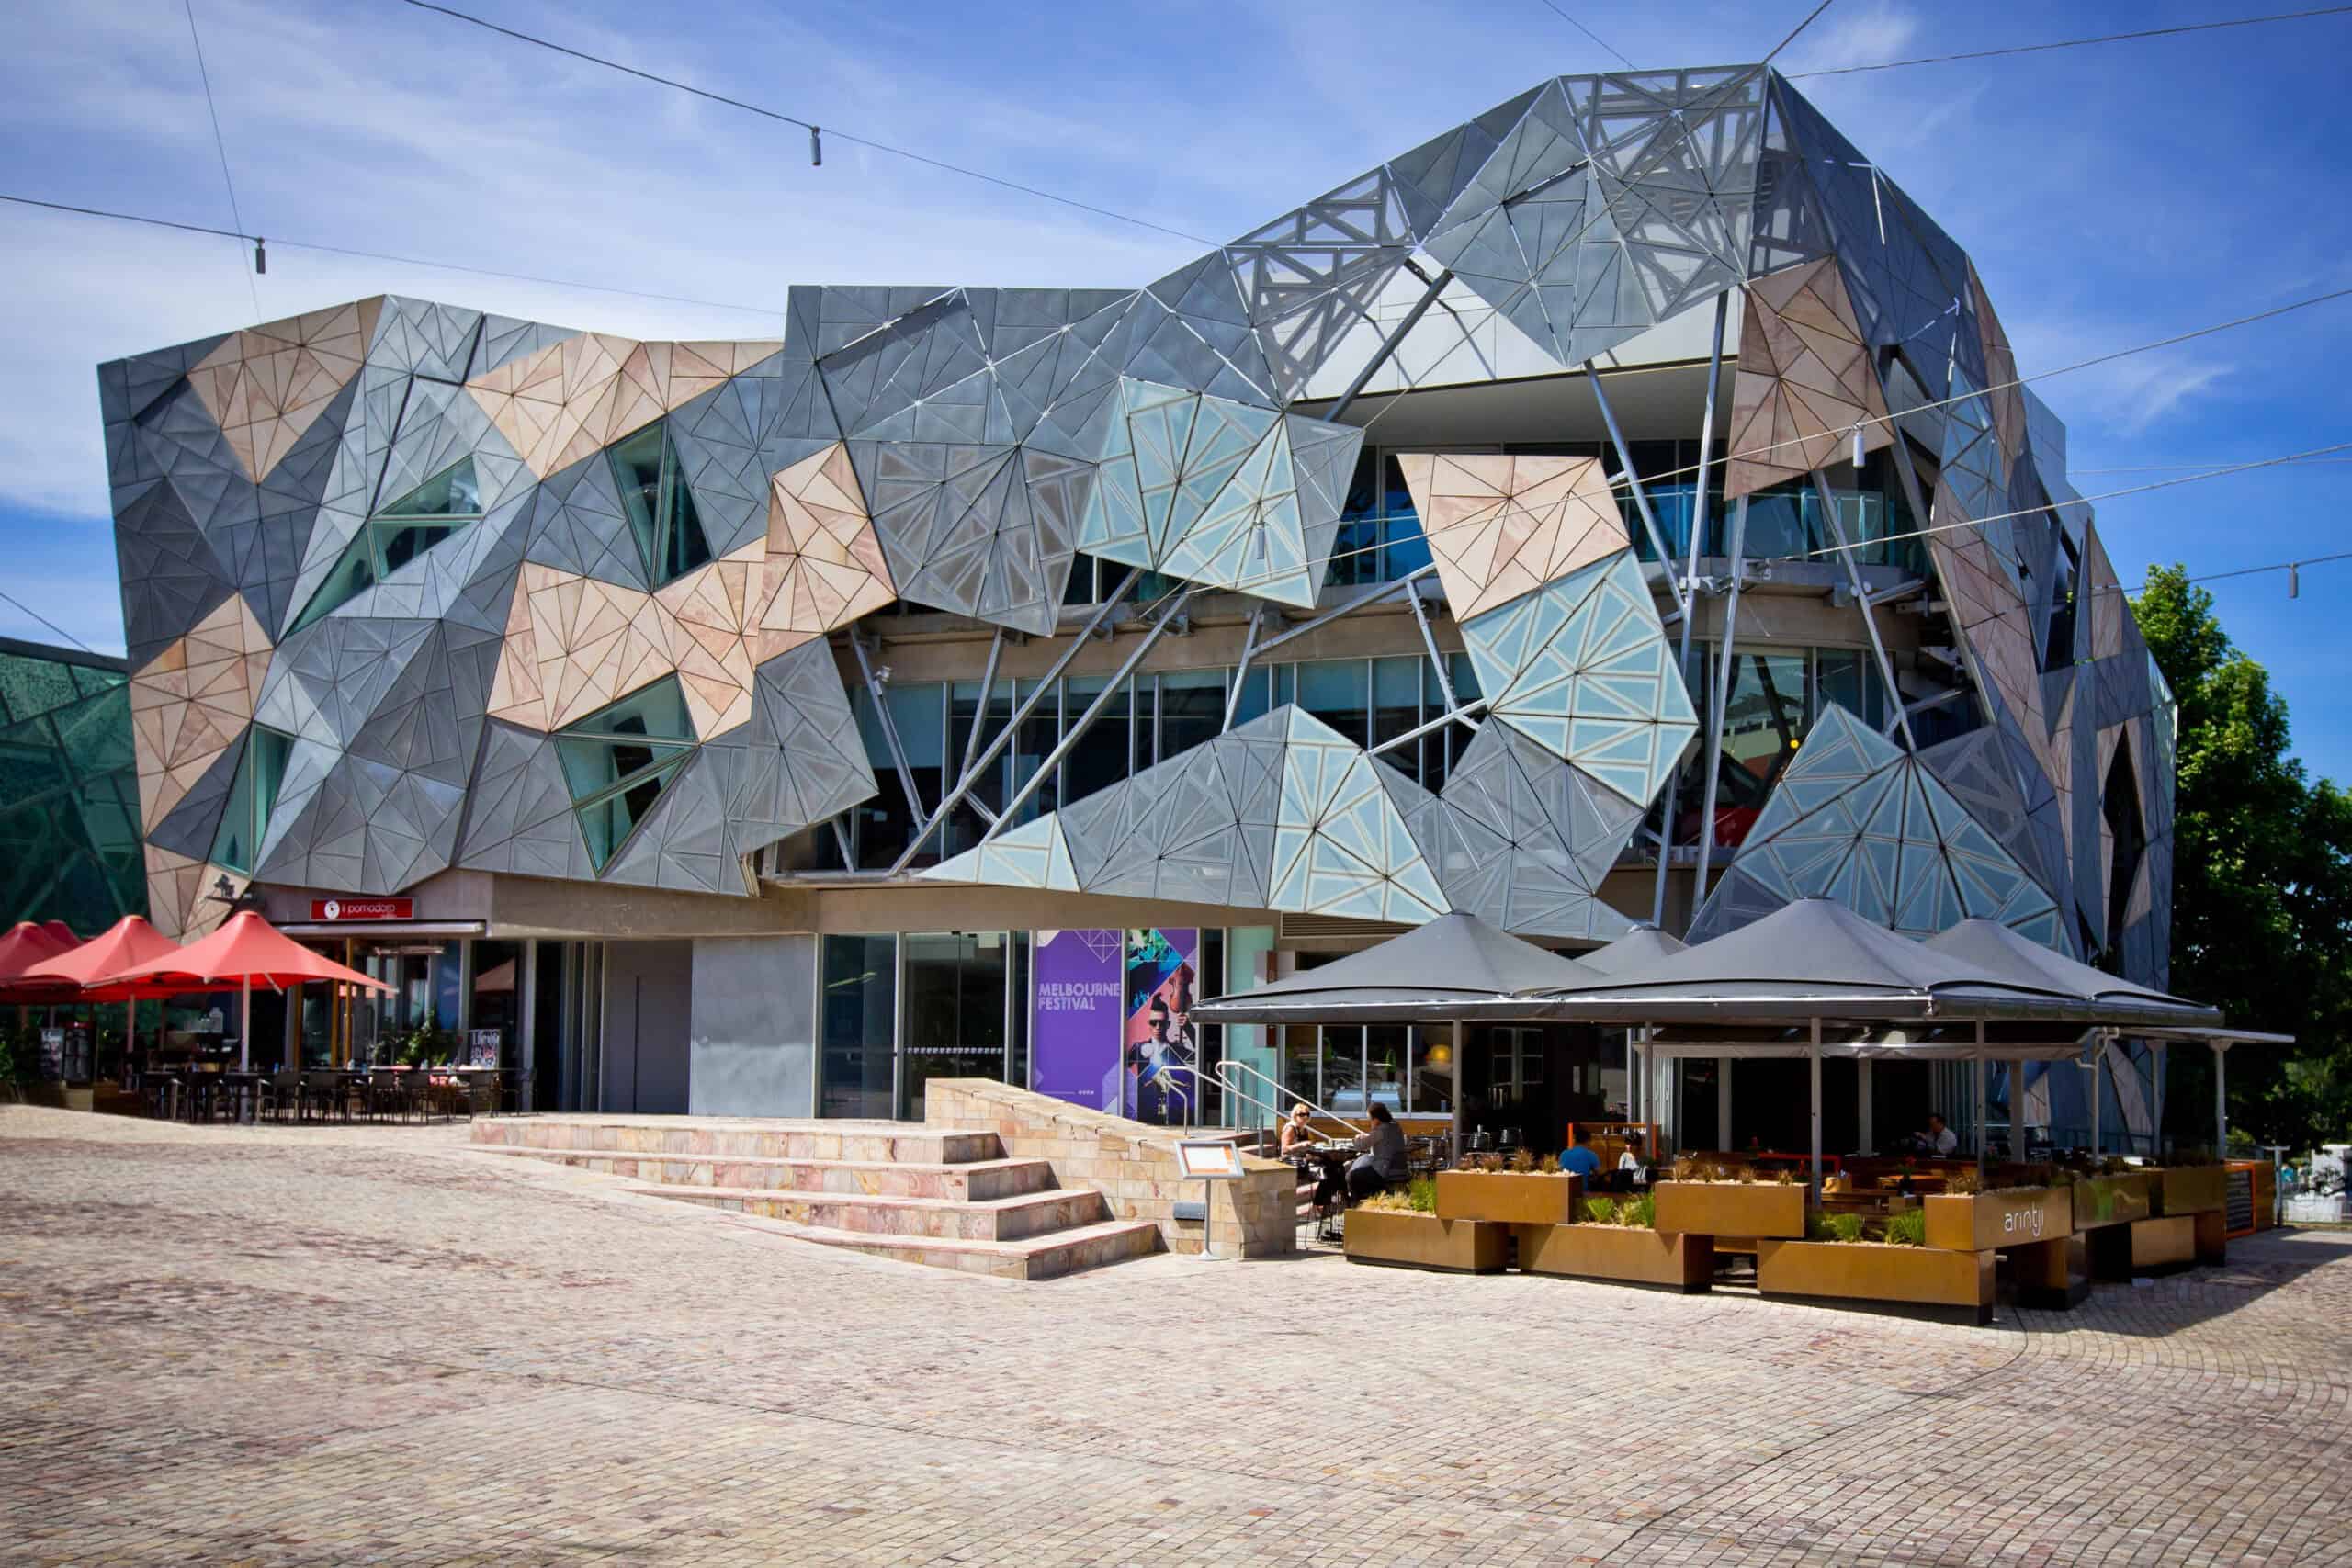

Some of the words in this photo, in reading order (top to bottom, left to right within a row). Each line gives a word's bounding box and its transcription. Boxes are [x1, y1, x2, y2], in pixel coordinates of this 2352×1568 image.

[348, 904, 396, 913] pomodoro
[1038, 983, 1120, 997] MELBOURNE
[1038, 997, 1095, 1010] FESTIVAL
